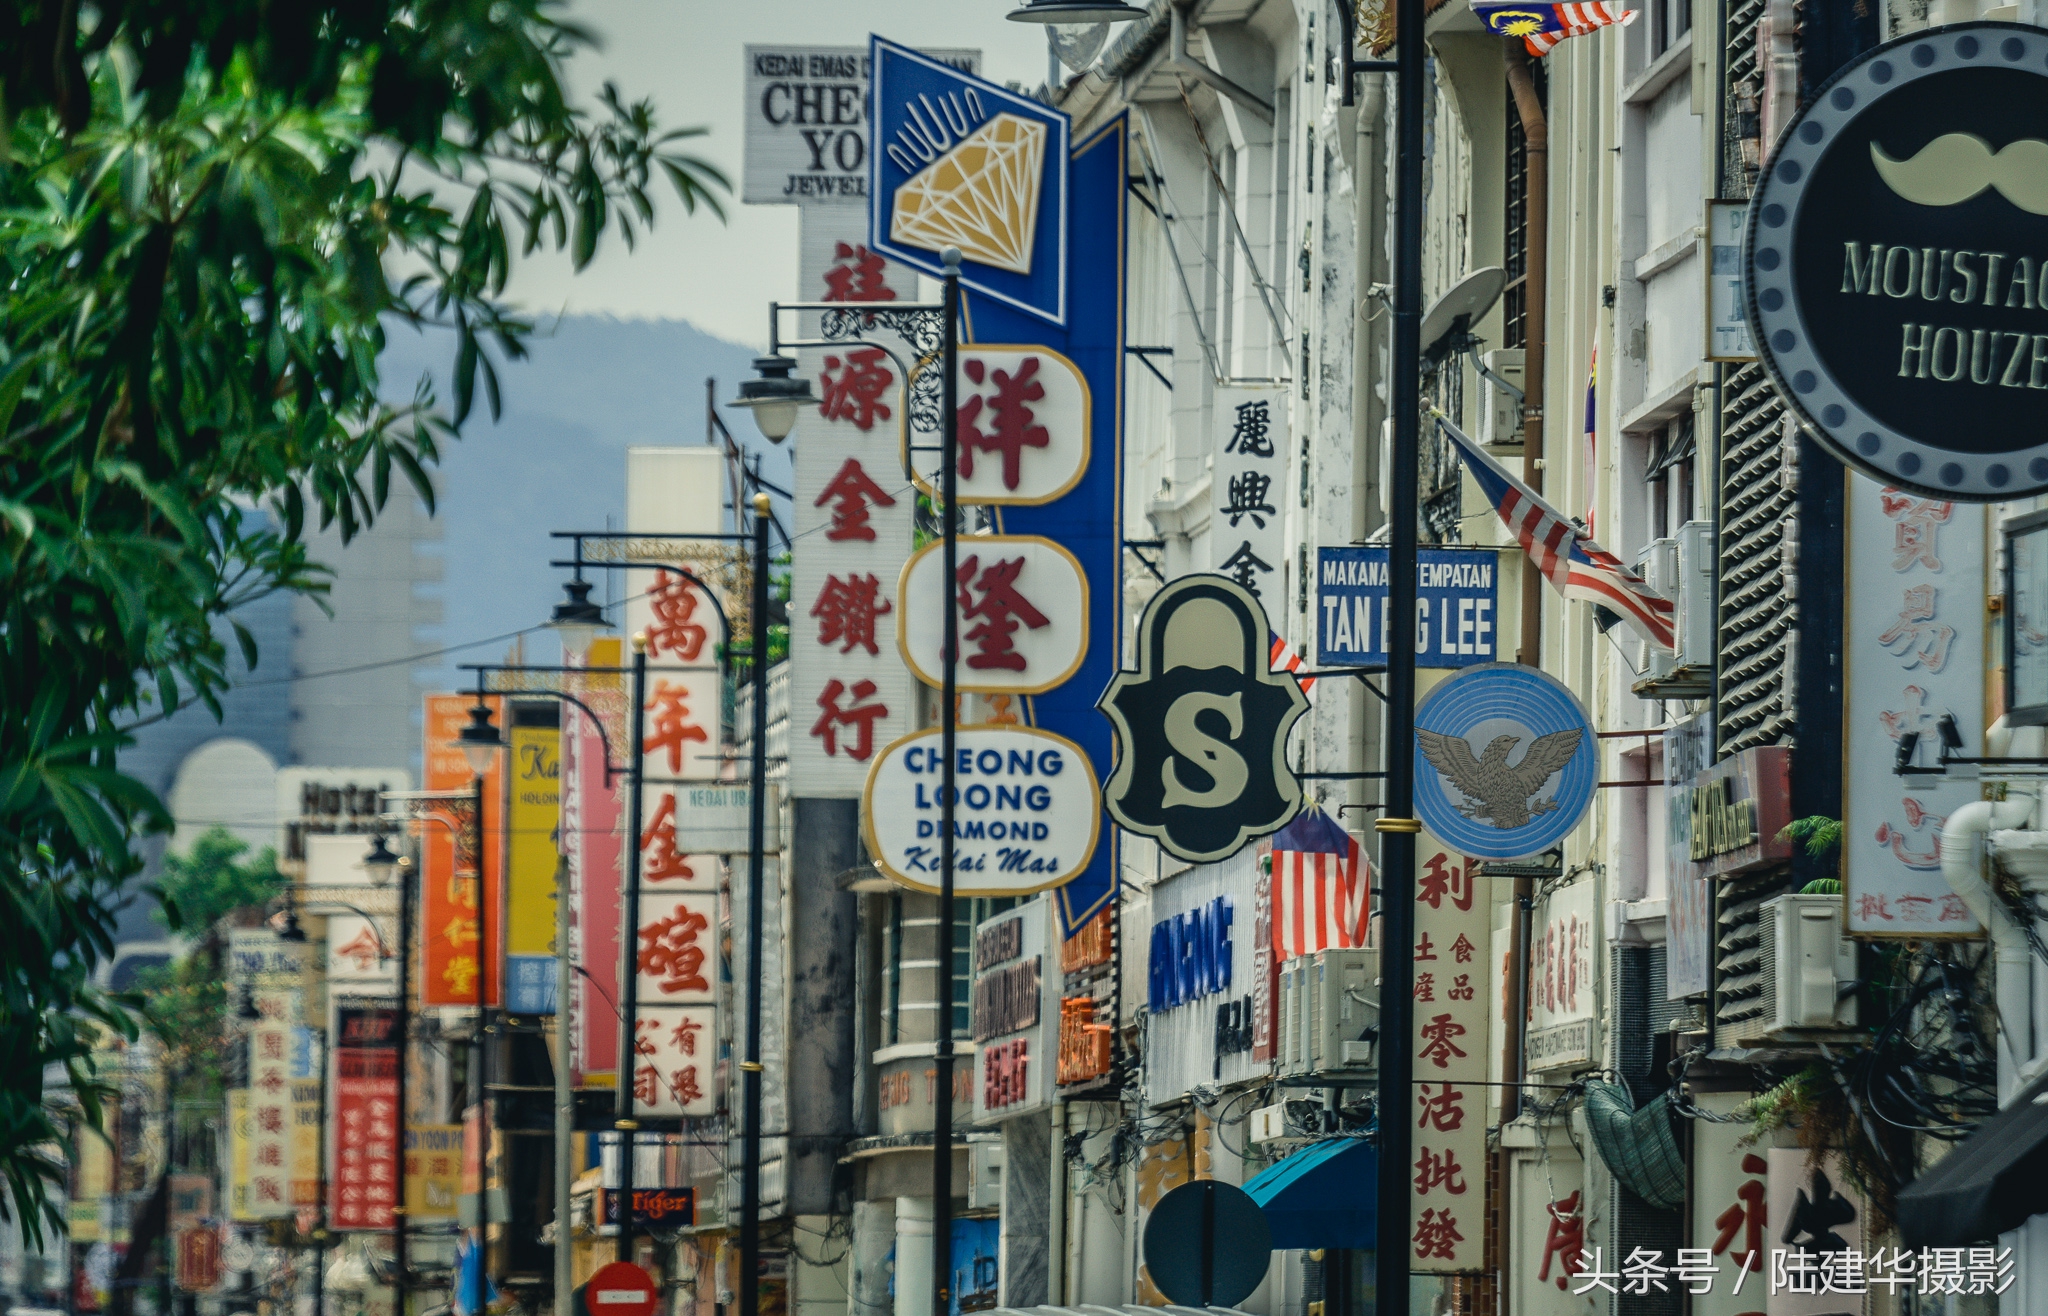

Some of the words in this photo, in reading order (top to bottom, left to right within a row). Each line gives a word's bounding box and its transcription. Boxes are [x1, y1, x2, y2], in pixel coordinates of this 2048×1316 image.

[808, 54, 856, 78] EMAS
[760, 80, 869, 127] CHE
[801, 128, 865, 172] YO
[783, 174, 869, 197] JEWEL
[1897, 322, 2048, 391] HOUZE
[1322, 560, 1391, 587] MAKANA
[1416, 563, 1492, 588] EMPATAN
[1323, 595, 1371, 653] TAN
[1380, 596, 1430, 655] EG
[1440, 597, 1491, 656] LEE
[520, 743, 559, 780] Ka
[903, 746, 1064, 777] CHEONG
[1161, 691, 1249, 809] S
[521, 792, 559, 806] HOLDIN
[731, 789, 751, 808] UB
[914, 782, 1052, 812] LOONG
[916, 819, 1049, 842] DIAMOND
[995, 846, 1059, 874] Mas
[1448, 932, 1475, 1001] 食品
